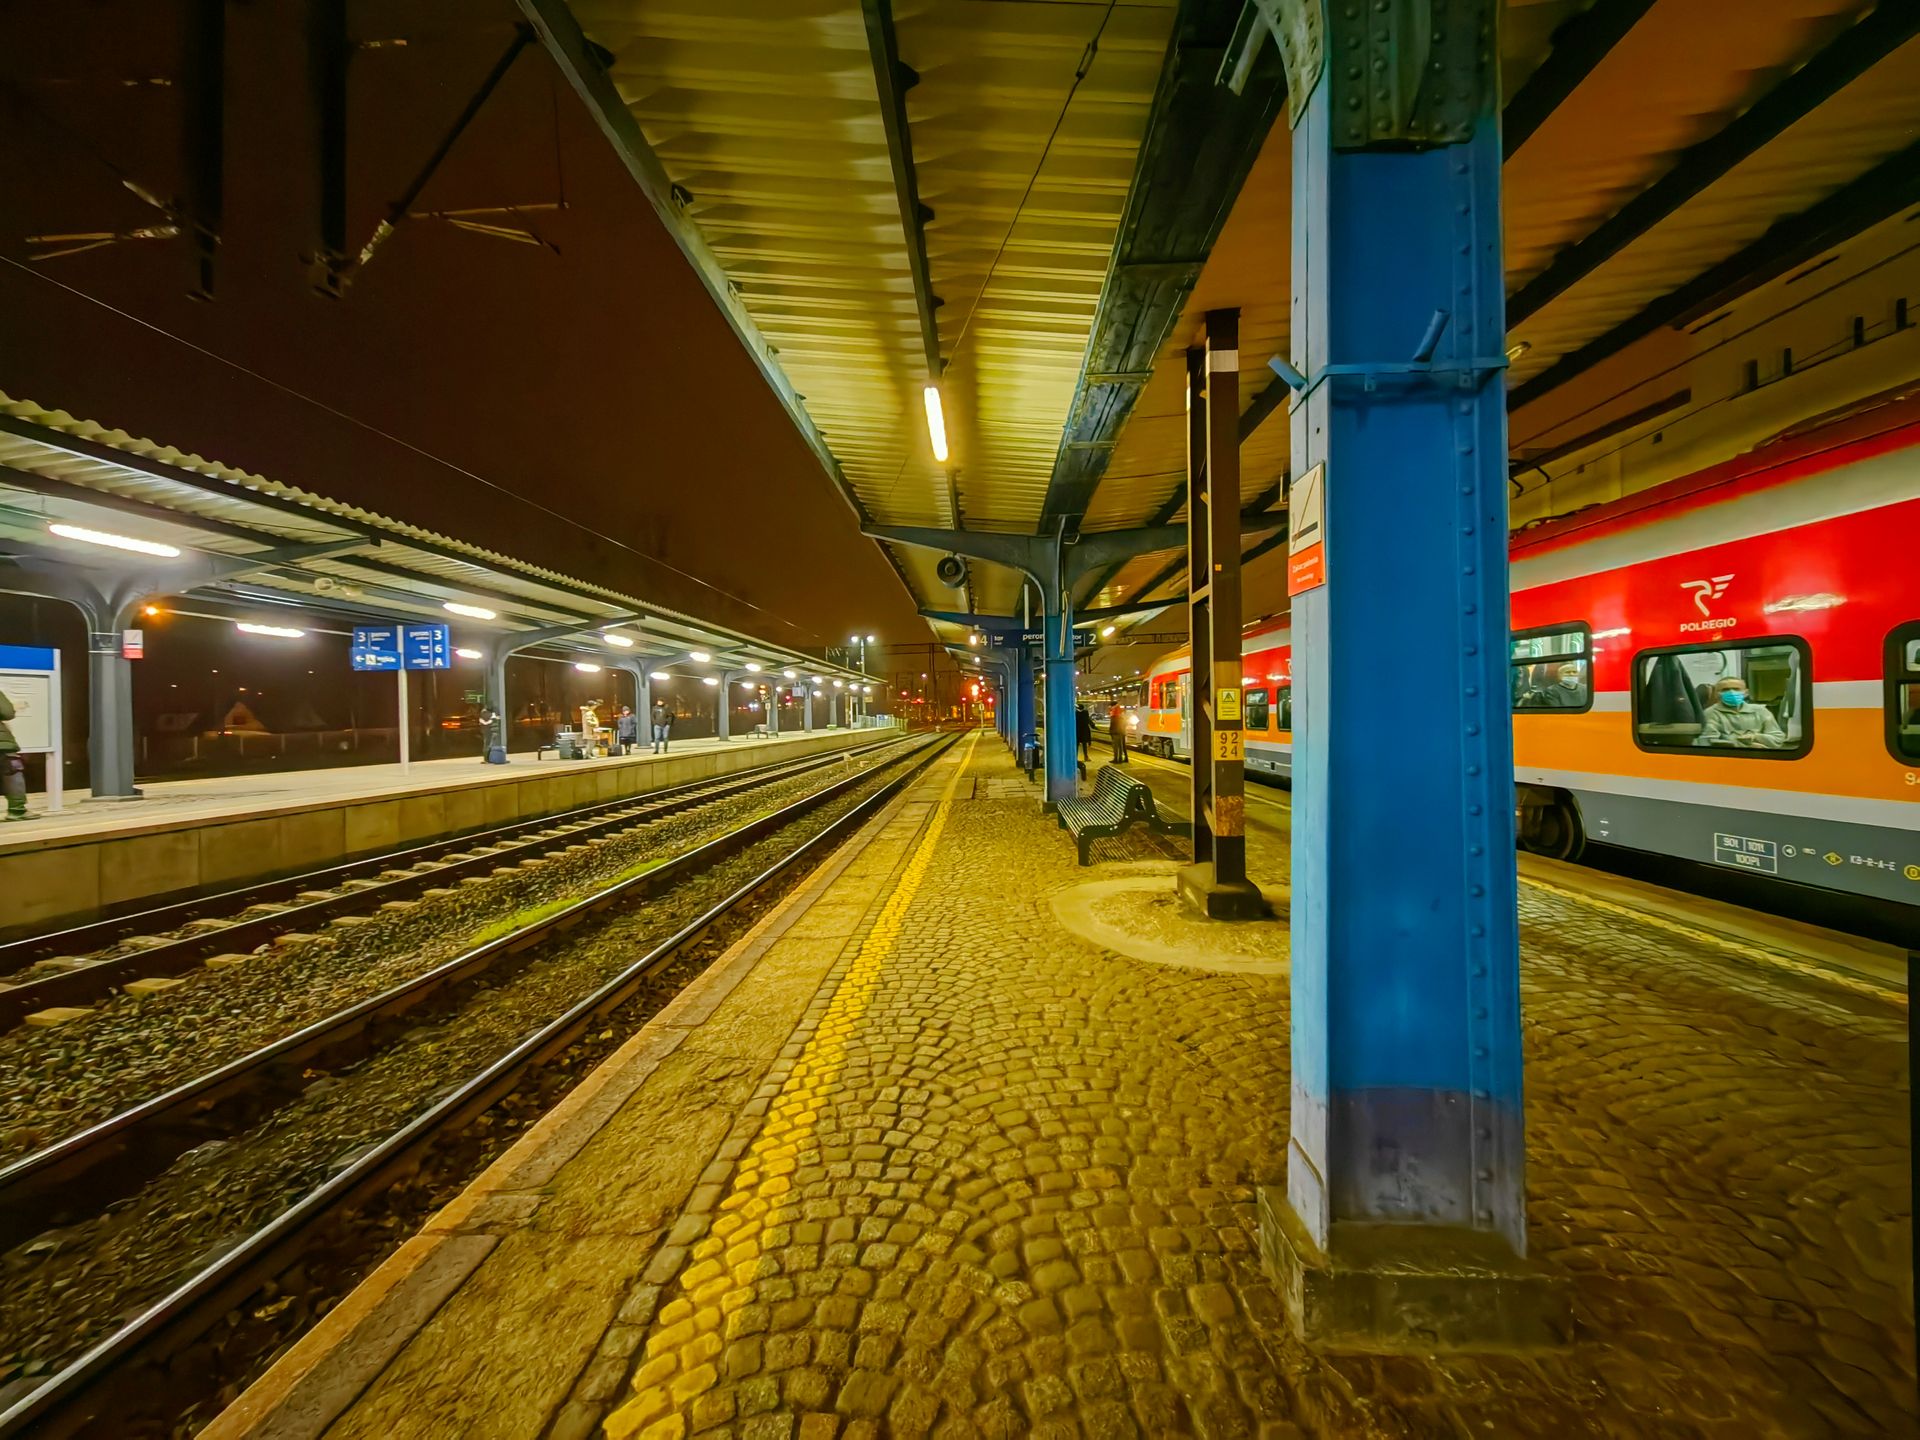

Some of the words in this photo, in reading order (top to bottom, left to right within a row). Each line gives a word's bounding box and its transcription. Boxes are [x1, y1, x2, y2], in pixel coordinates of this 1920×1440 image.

[1680, 617, 1737, 633] POLREGIO
[357, 632, 366, 642] 3
[433, 630, 442, 641] 3
[980, 635, 988, 646] 4
[1088, 634, 1097, 645] 2
[434, 644, 443, 653] 6
[434, 657, 443, 667] A
